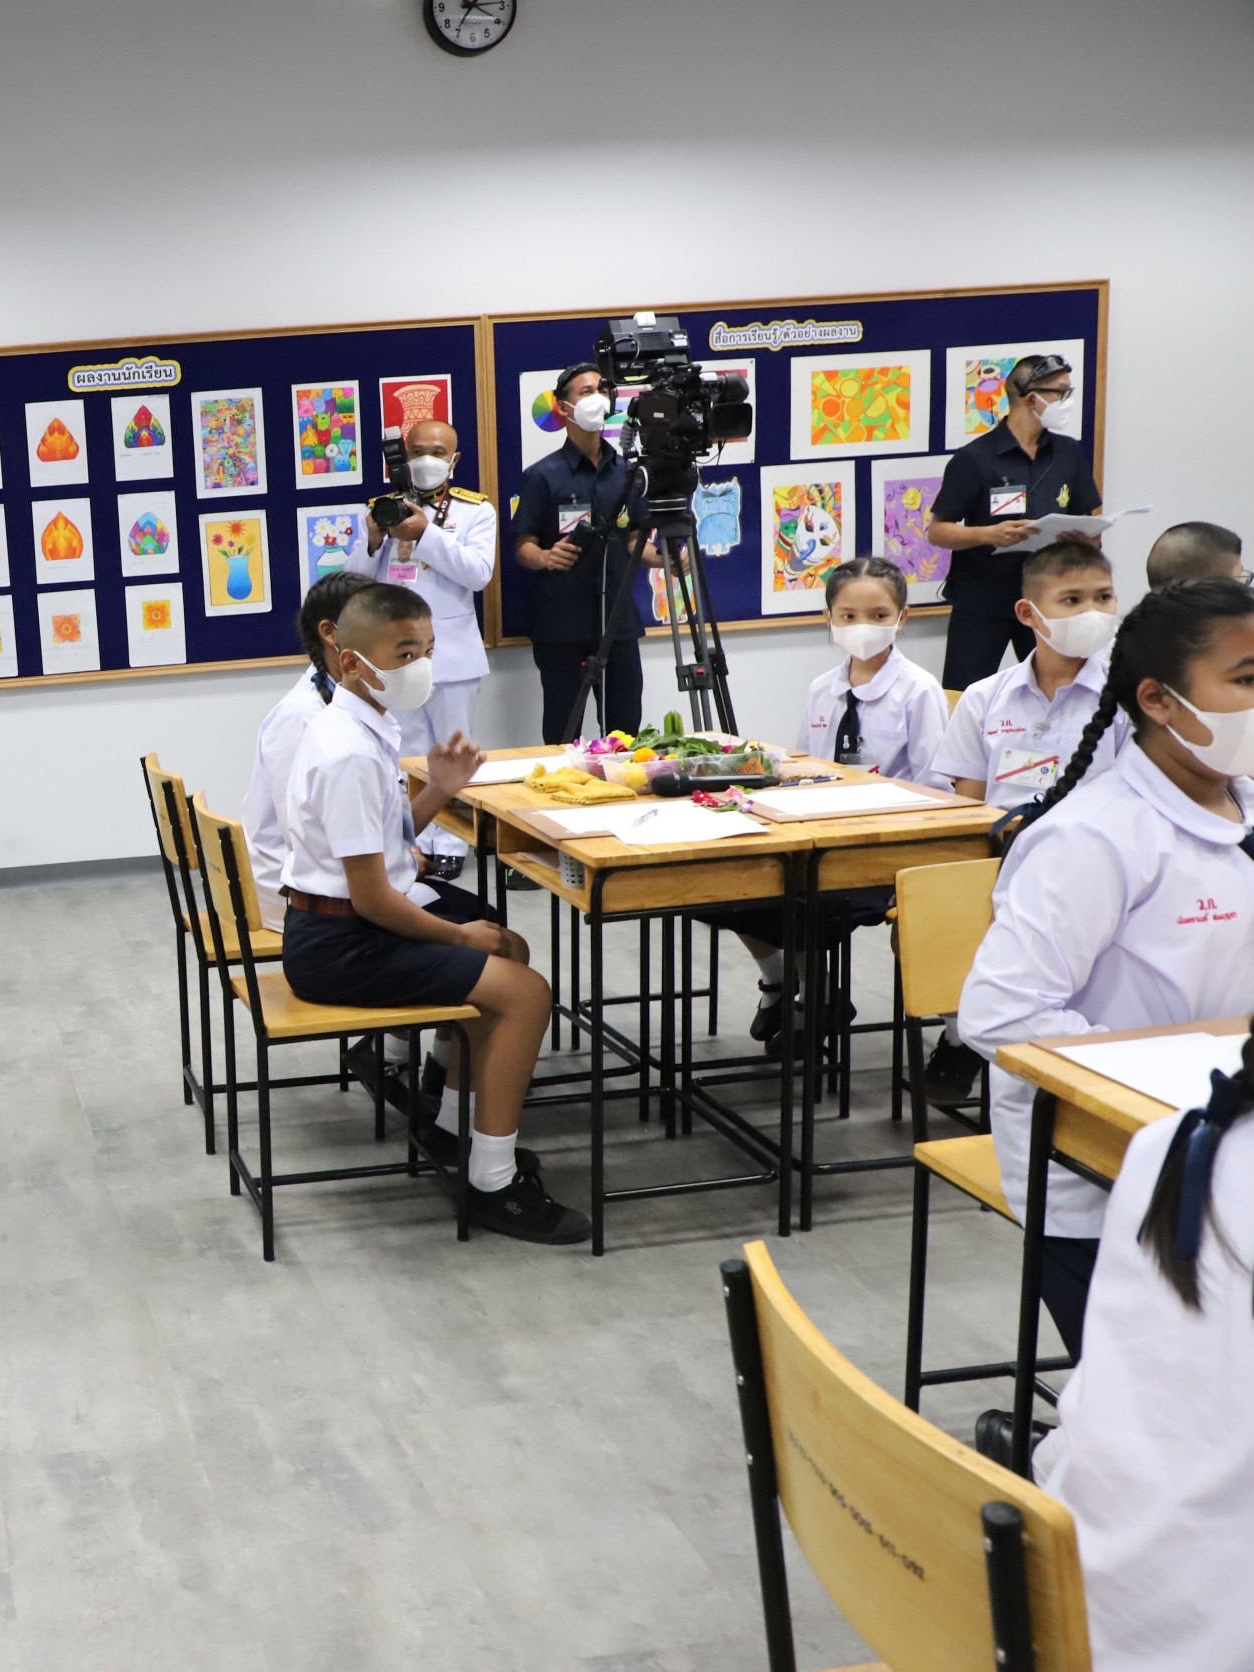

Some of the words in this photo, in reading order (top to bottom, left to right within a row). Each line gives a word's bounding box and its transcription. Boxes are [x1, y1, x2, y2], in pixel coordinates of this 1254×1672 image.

[438, 2, 445, 12] 9
[499, 1, 505, 10] 3
[444, 18, 451, 29] 8
[455, 29, 461, 38] 7
[469, 32, 476, 42] 6
[483, 28, 490, 38] 5
[714, 325, 857, 345] สื่อการเรียนรู้/ตัวอย่างผลงาน
[76, 364, 173, 384] ผลงานนักเรียน
